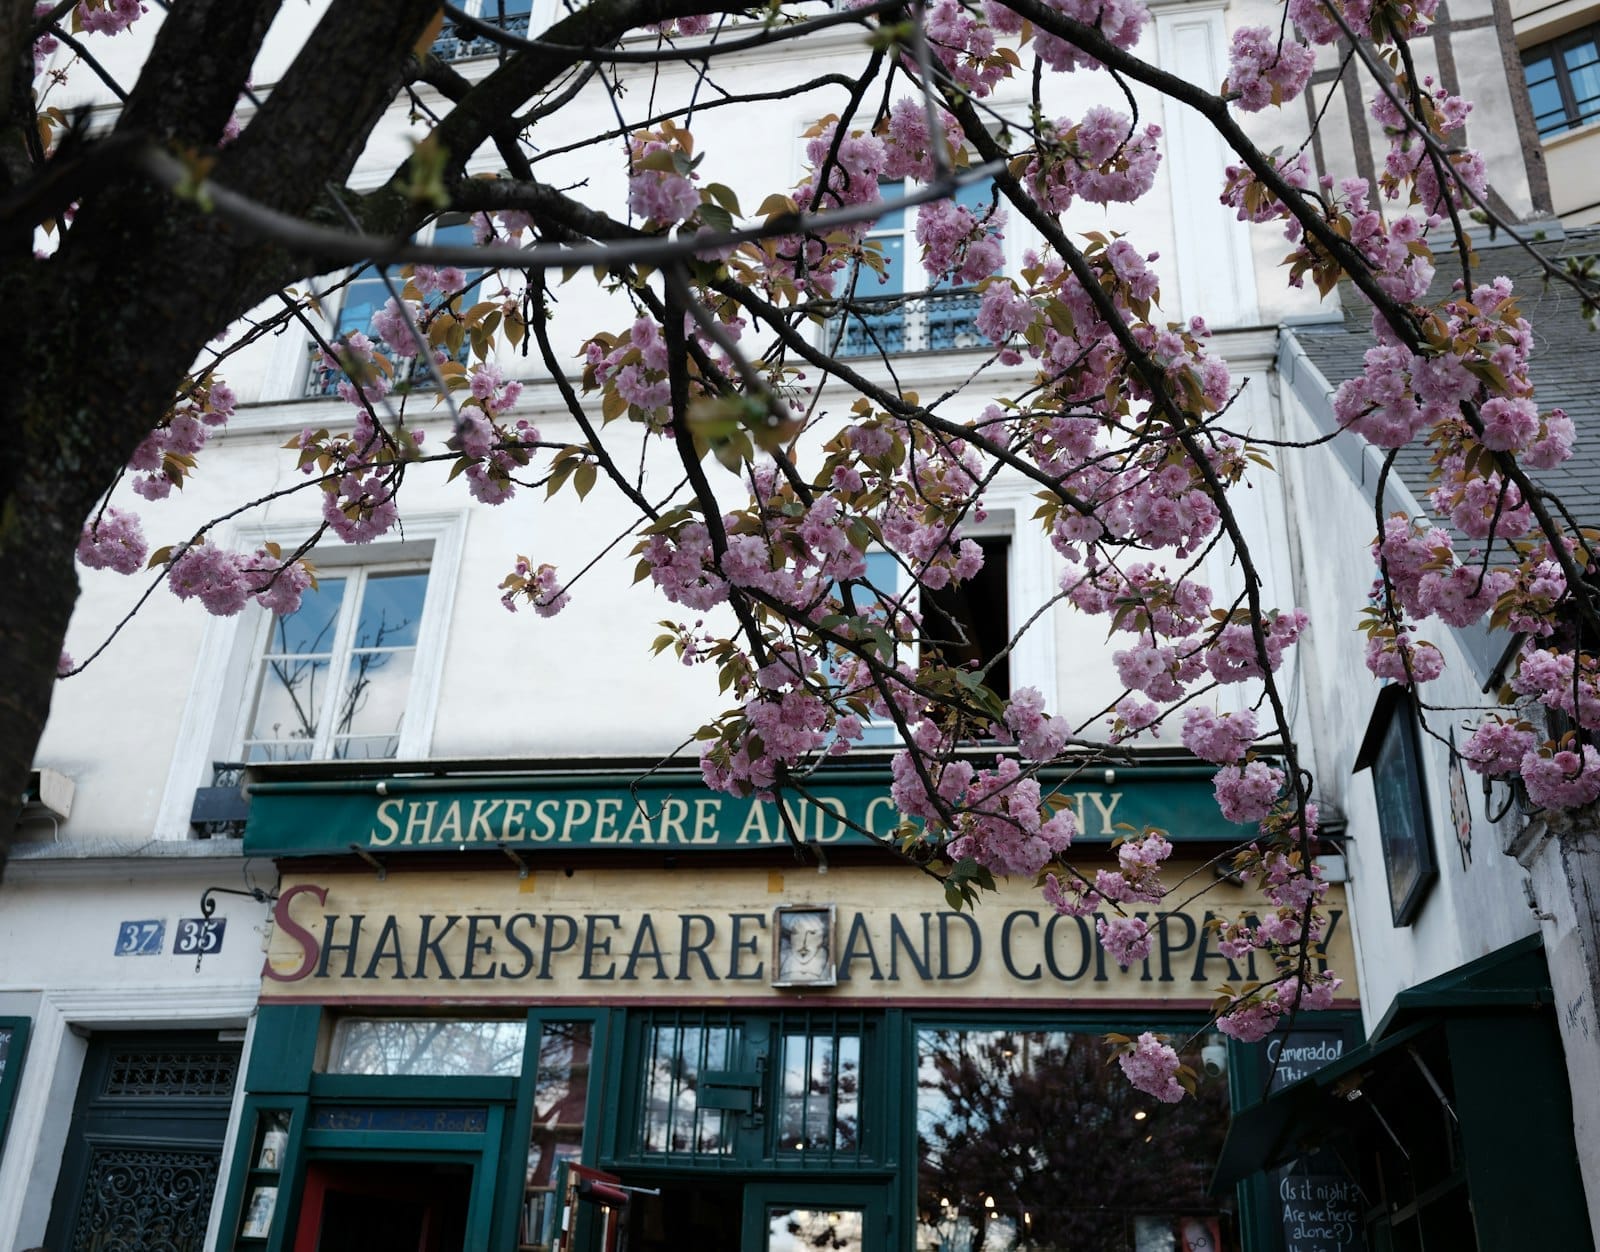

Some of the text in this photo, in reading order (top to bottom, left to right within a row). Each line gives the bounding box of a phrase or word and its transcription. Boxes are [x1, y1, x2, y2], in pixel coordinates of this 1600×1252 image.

[370, 798, 722, 846] SHAKESPEARE
[735, 796, 847, 845] AND
[122, 923, 159, 953] 37
[180, 920, 218, 951] 35
[262, 883, 766, 982] SHAKESPEARE
[837, 911, 982, 981] AND
[1267, 1039, 1343, 1063] Camerado!
[1276, 1066, 1308, 1082] Thi
[1280, 1177, 1297, 1202] (Is
[1301, 1179, 1313, 1200] it
[1282, 1203, 1358, 1223] Are we here
[1292, 1221, 1353, 1244] alone?)
